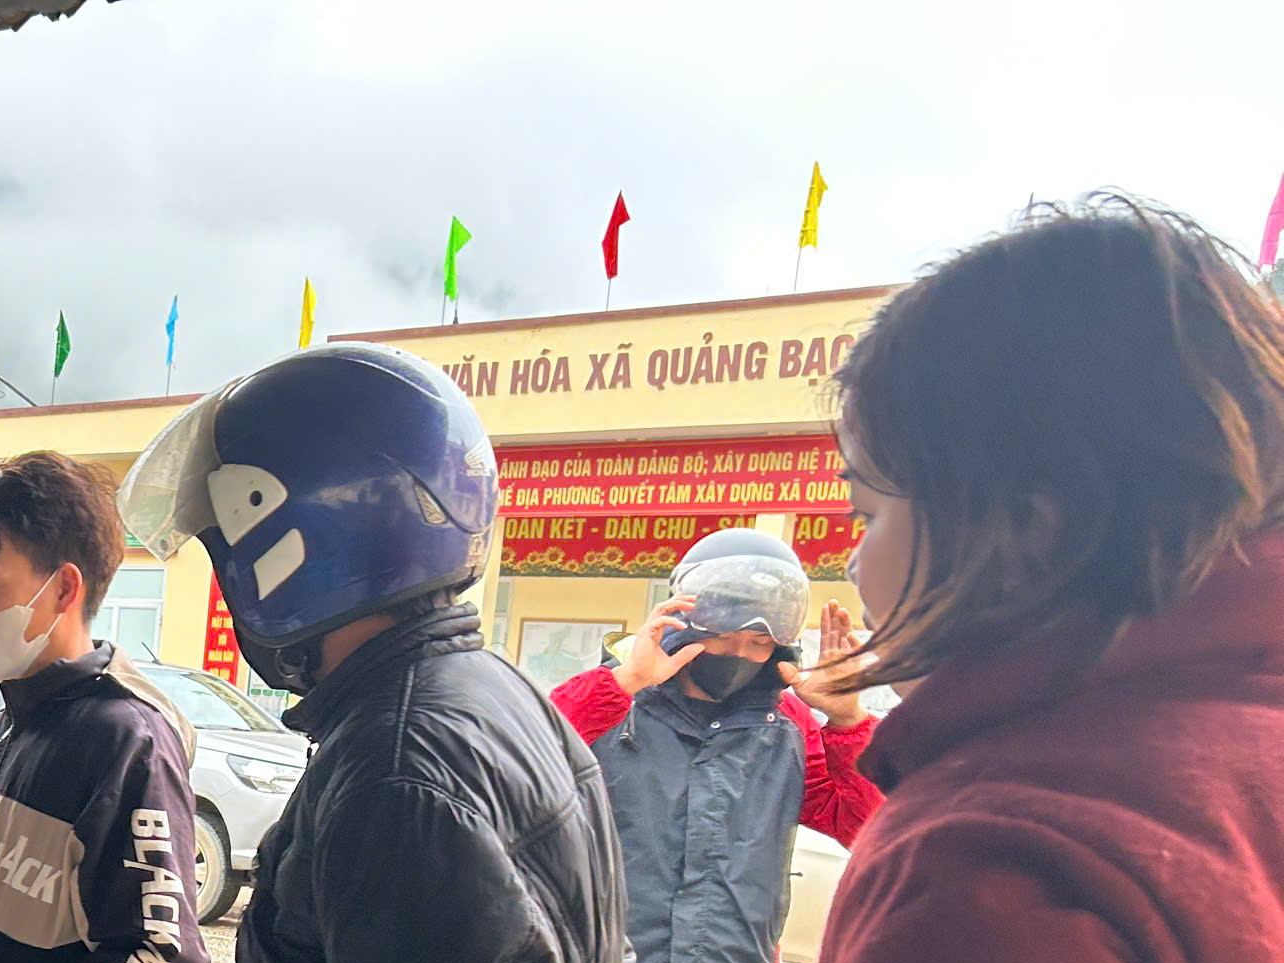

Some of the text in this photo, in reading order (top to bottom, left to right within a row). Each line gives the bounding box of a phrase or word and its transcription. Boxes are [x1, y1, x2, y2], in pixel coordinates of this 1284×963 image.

[509, 348, 572, 395] HÓA
[584, 342, 633, 391] XÃ
[646, 332, 768, 391] QUẢNG
[778, 334, 855, 387] BẠC
[499, 458, 528, 479] ÃNH
[531, 459, 559, 481] ĐẠO
[563, 452, 591, 477] CỦA
[596, 454, 634, 476] TOÀN
[637, 449, 679, 475] ĐẢNG
[712, 450, 744, 473] XÂY
[748, 450, 793, 476] DỰNG
[797, 447, 820, 474] HỆ
[824, 450, 845, 470] TH
[516, 487, 539, 510] ĐỊA
[609, 480, 655, 506] QUYẾT
[659, 481, 691, 504] TÂM
[694, 480, 726, 504] XÂY
[729, 481, 774, 507] DỰNG
[777, 478, 801, 501] XÃ
[796, 516, 828, 544] ẠO
